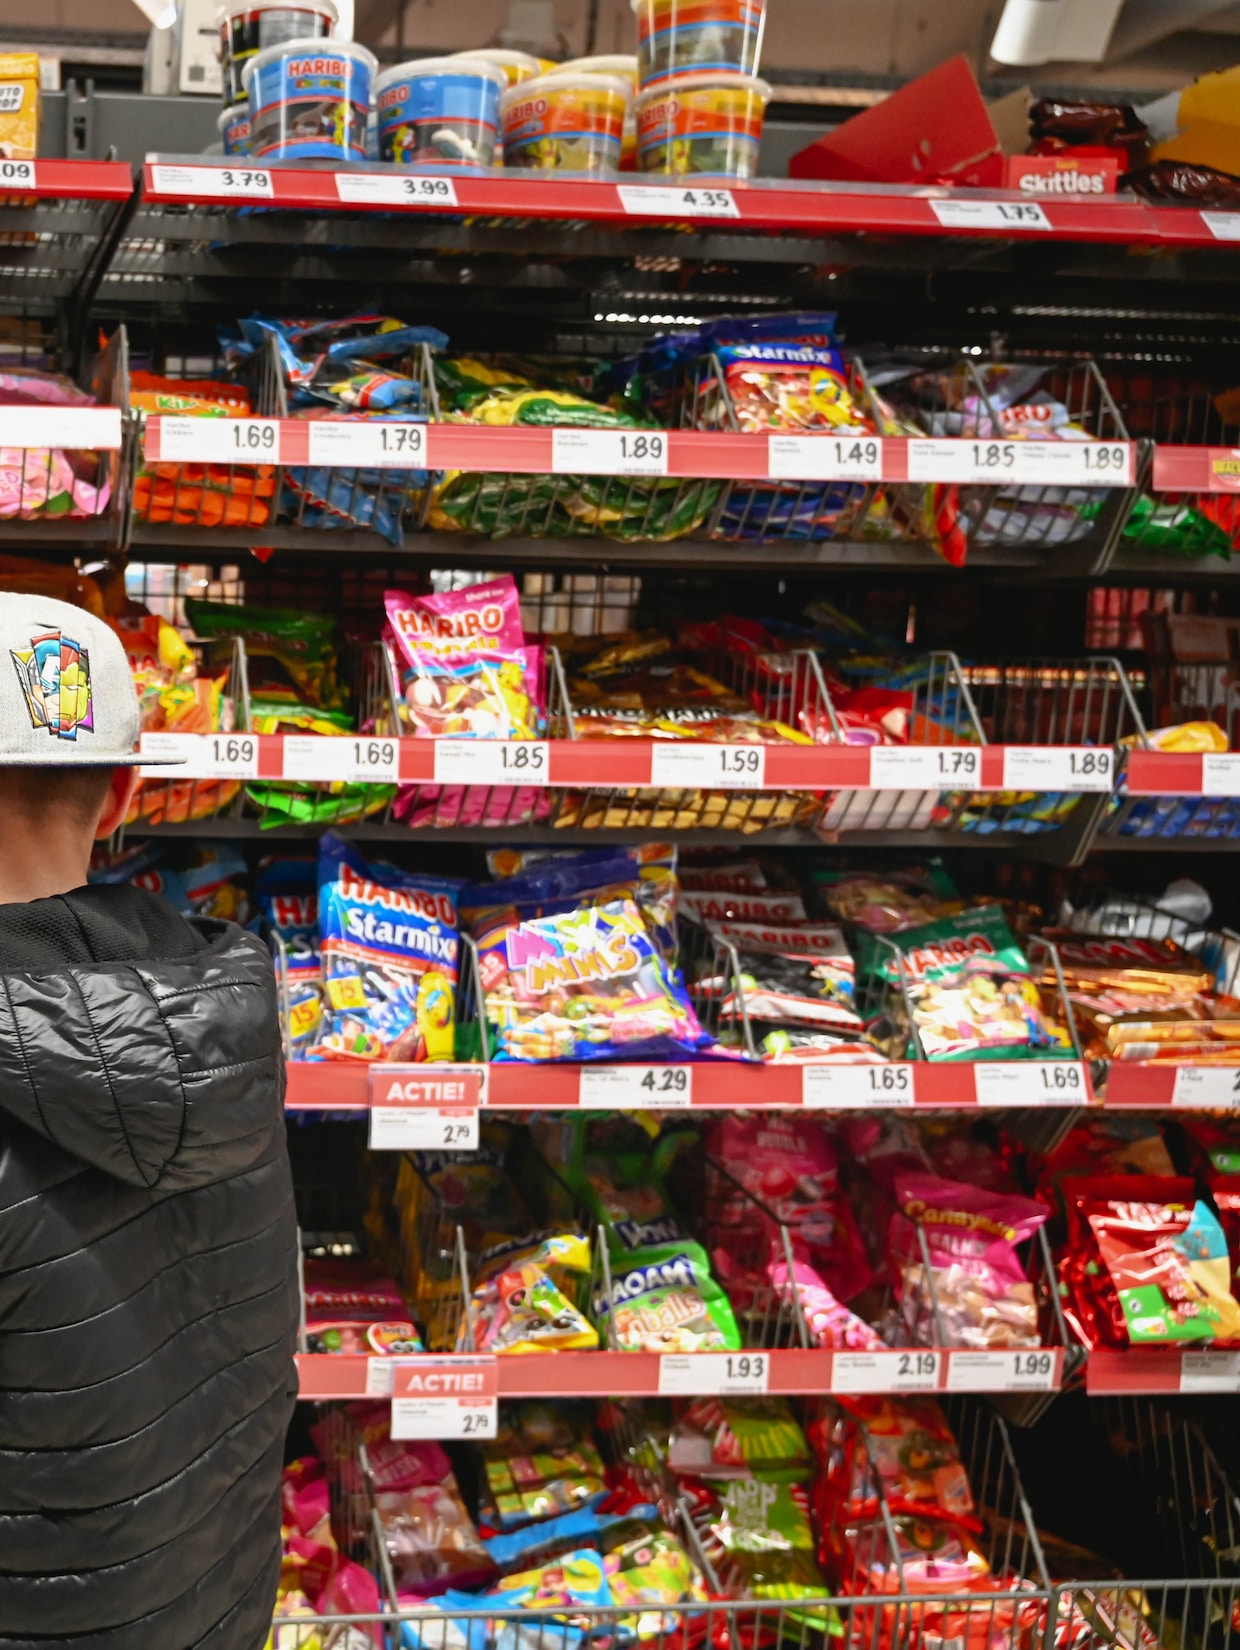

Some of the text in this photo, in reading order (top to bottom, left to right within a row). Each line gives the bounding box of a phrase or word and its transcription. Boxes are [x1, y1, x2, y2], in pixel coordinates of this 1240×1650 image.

[288, 60, 353, 79] HARIBO
[221, 171, 268, 187] 3.79
[403, 180, 449, 196] 3.99
[1019, 170, 1105, 194] Skittles
[683, 192, 729, 208] 4.35
[996, 205, 1040, 221] 1.75
[736, 345, 829, 365] Starmix
[233, 425, 275, 448] 1.69
[381, 428, 422, 451] 1.79
[620, 436, 662, 459] 1.89
[834, 442, 877, 465] 1.49
[973, 444, 1014, 467] 1.85
[1083, 447, 1124, 470] 1.89
[397, 607, 503, 639] HARIBO
[213, 740, 254, 763] 1.69
[354, 743, 395, 765] 1.69
[501, 747, 543, 769] 1.85
[720, 751, 759, 772] 1.59
[938, 752, 976, 773] 1.79
[1070, 753, 1109, 774] 1.89
[340, 864, 457, 926] HARIBO
[346, 907, 451, 959] Starmix
[531, 935, 638, 990] MINIS
[641, 1069, 687, 1091] 4.29
[869, 1068, 908, 1090] 1.65
[1041, 1067, 1080, 1089] 1.69
[386, 1081, 465, 1101] ACTIE!
[726, 1357, 763, 1378] 1.93
[898, 1355, 936, 1375] 2.19
[1014, 1355, 1051, 1376] 1.99
[406, 1373, 484, 1392] ACTIE!
